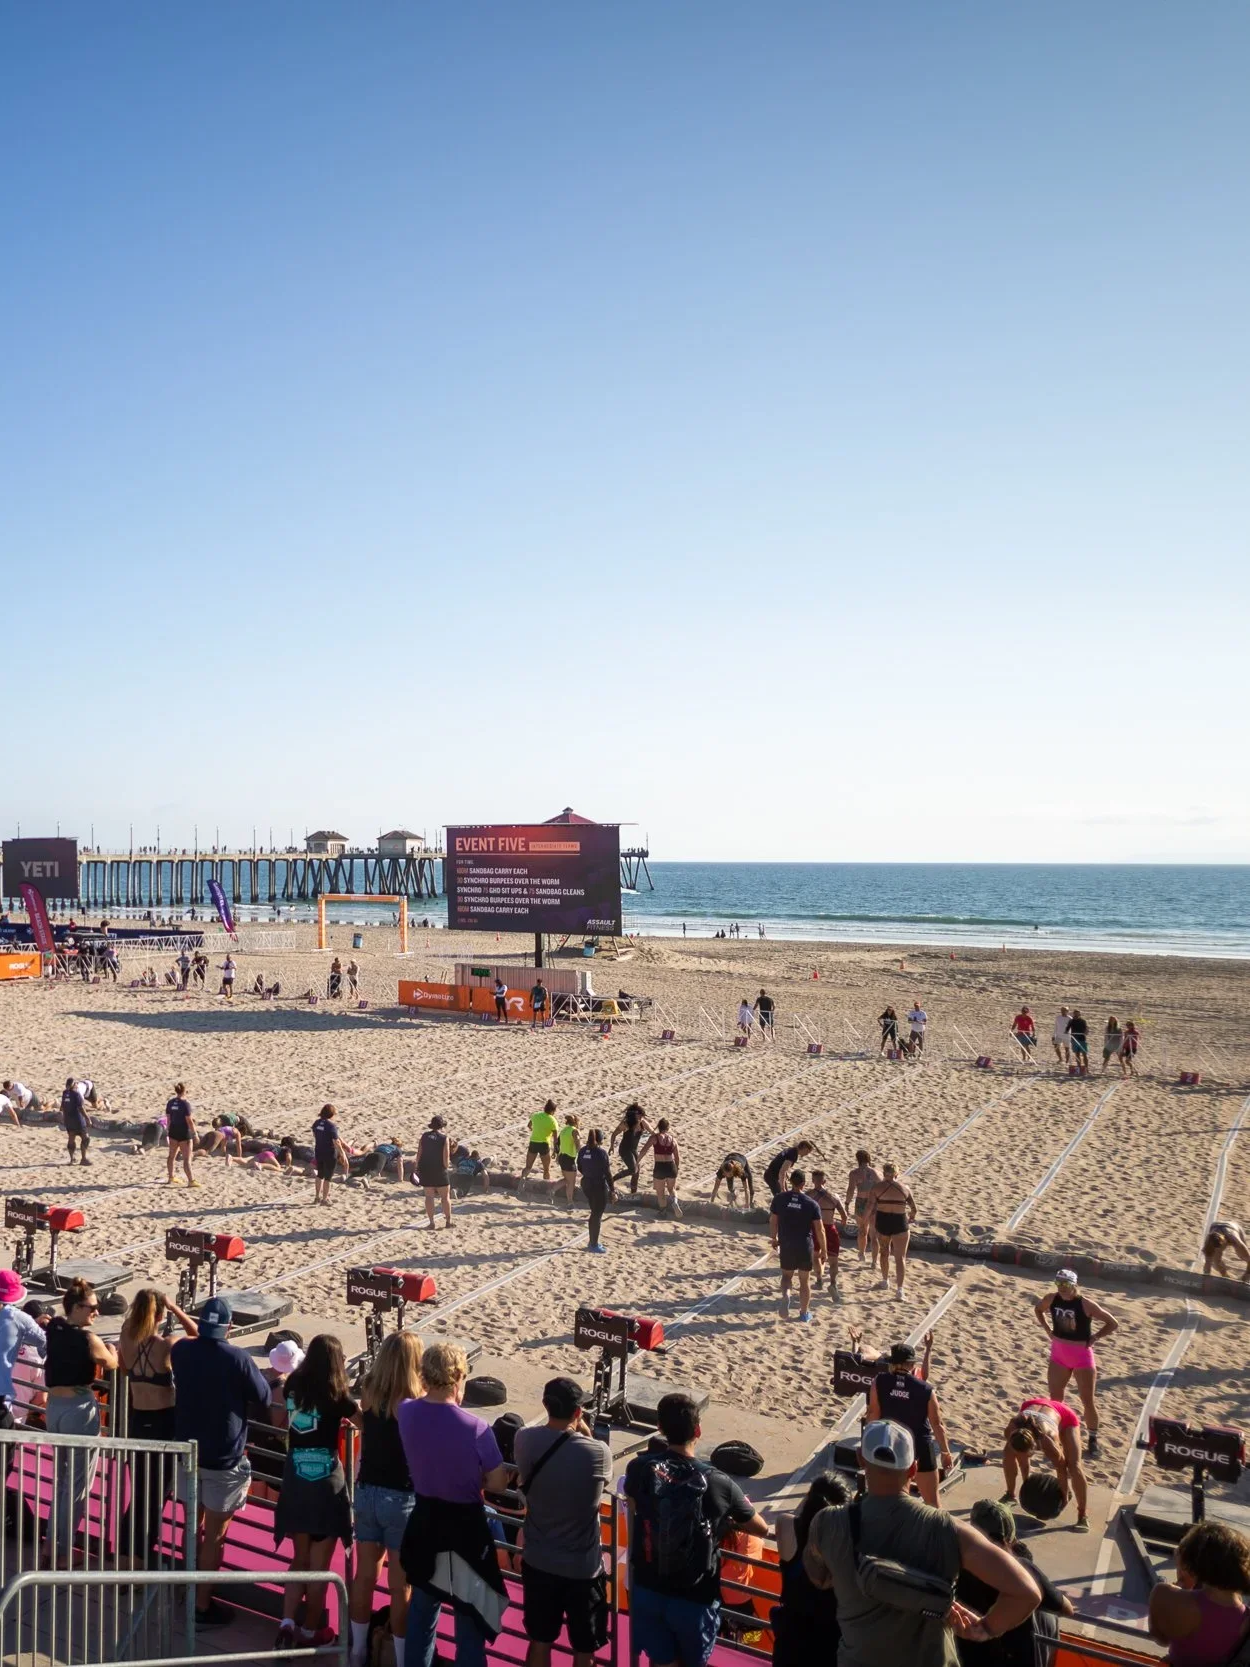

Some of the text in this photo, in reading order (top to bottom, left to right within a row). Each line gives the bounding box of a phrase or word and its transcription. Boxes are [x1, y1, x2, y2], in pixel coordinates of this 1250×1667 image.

[455, 837, 526, 851] EVENT FIVE
[20, 861, 59, 878] YETI
[514, 877, 529, 885] OVER
[562, 888, 585, 896] CLEANS
[423, 991, 454, 1001] Dymatize
[505, 996, 524, 1012] YR
[1187, 1074, 1193, 1083] 2
[7, 1211, 34, 1222] ROGUE
[169, 1242, 200, 1254] ROGUE
[957, 1244, 991, 1253] ROGUE
[351, 1286, 388, 1299] ROGUE
[1054, 1307, 1075, 1318] TYR
[580, 1326, 622, 1344] ROGUE
[840, 1371, 875, 1385] ROG
[889, 1389, 910, 1399] JUDGE
[1164, 1443, 1230, 1465] ROGUE
